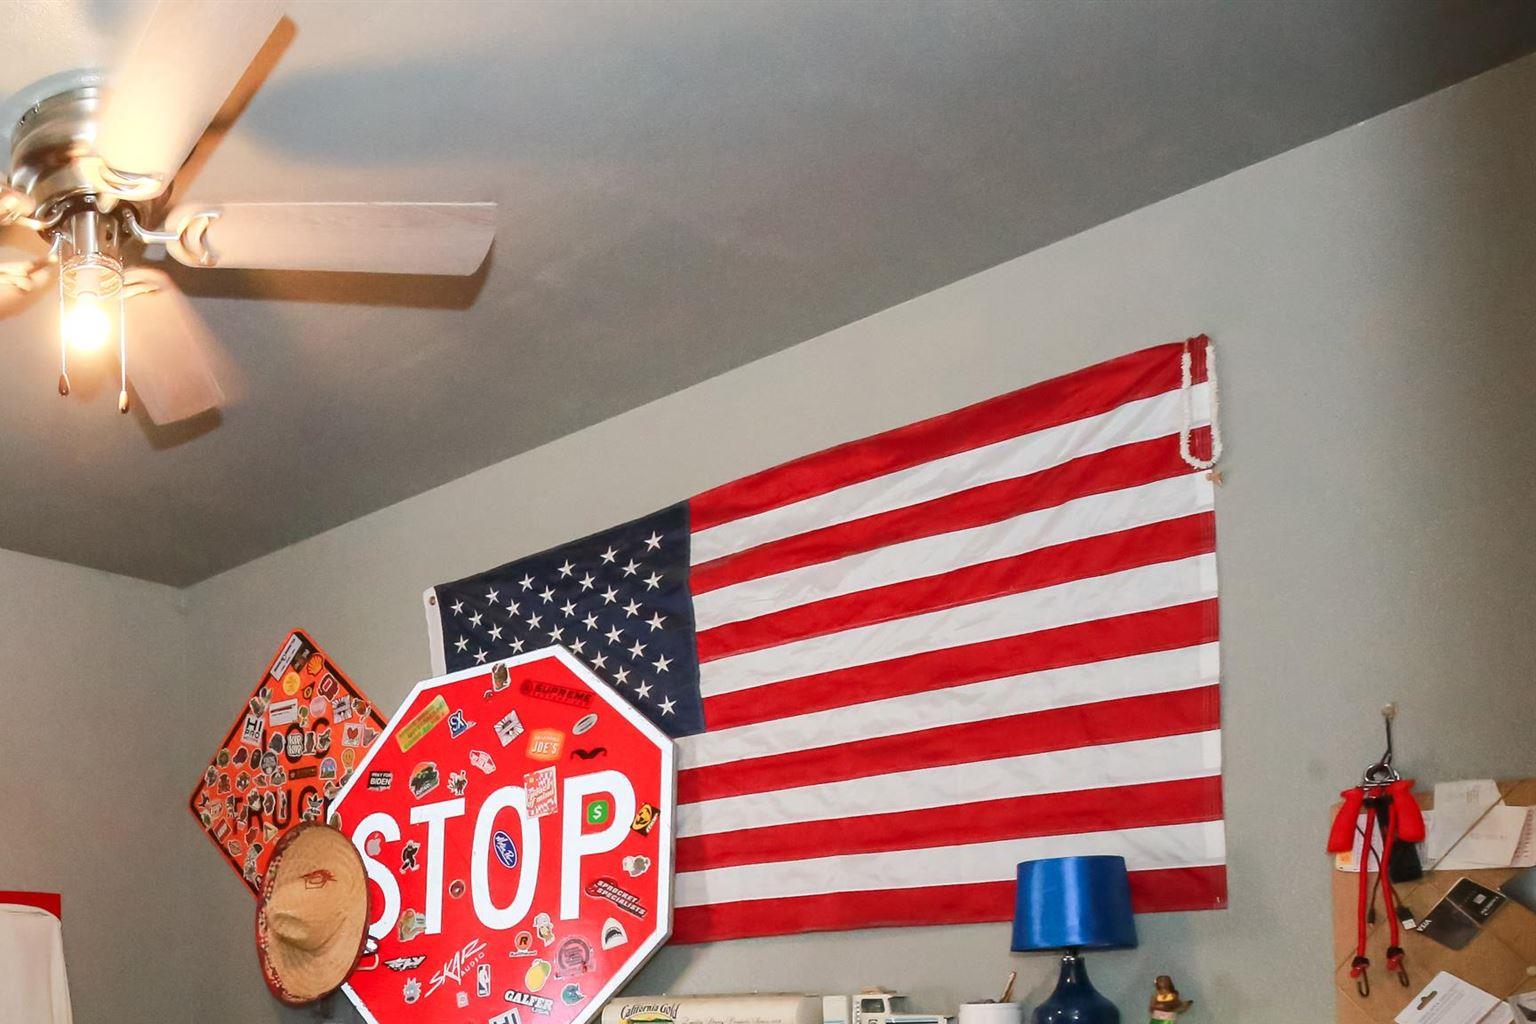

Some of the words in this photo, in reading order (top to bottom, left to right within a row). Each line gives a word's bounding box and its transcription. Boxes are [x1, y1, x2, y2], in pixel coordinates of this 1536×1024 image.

[246, 718, 263, 732] HI
[351, 769, 636, 942] STOP
[596, 887, 646, 915] SPECIALISTS
[597, 880, 639, 903] SPROCKET
[424, 938, 488, 998] SKAR
[460, 952, 486, 977] AUDIO
[620, 1004, 659, 1019] California
[659, 1003, 681, 1020] Gold
